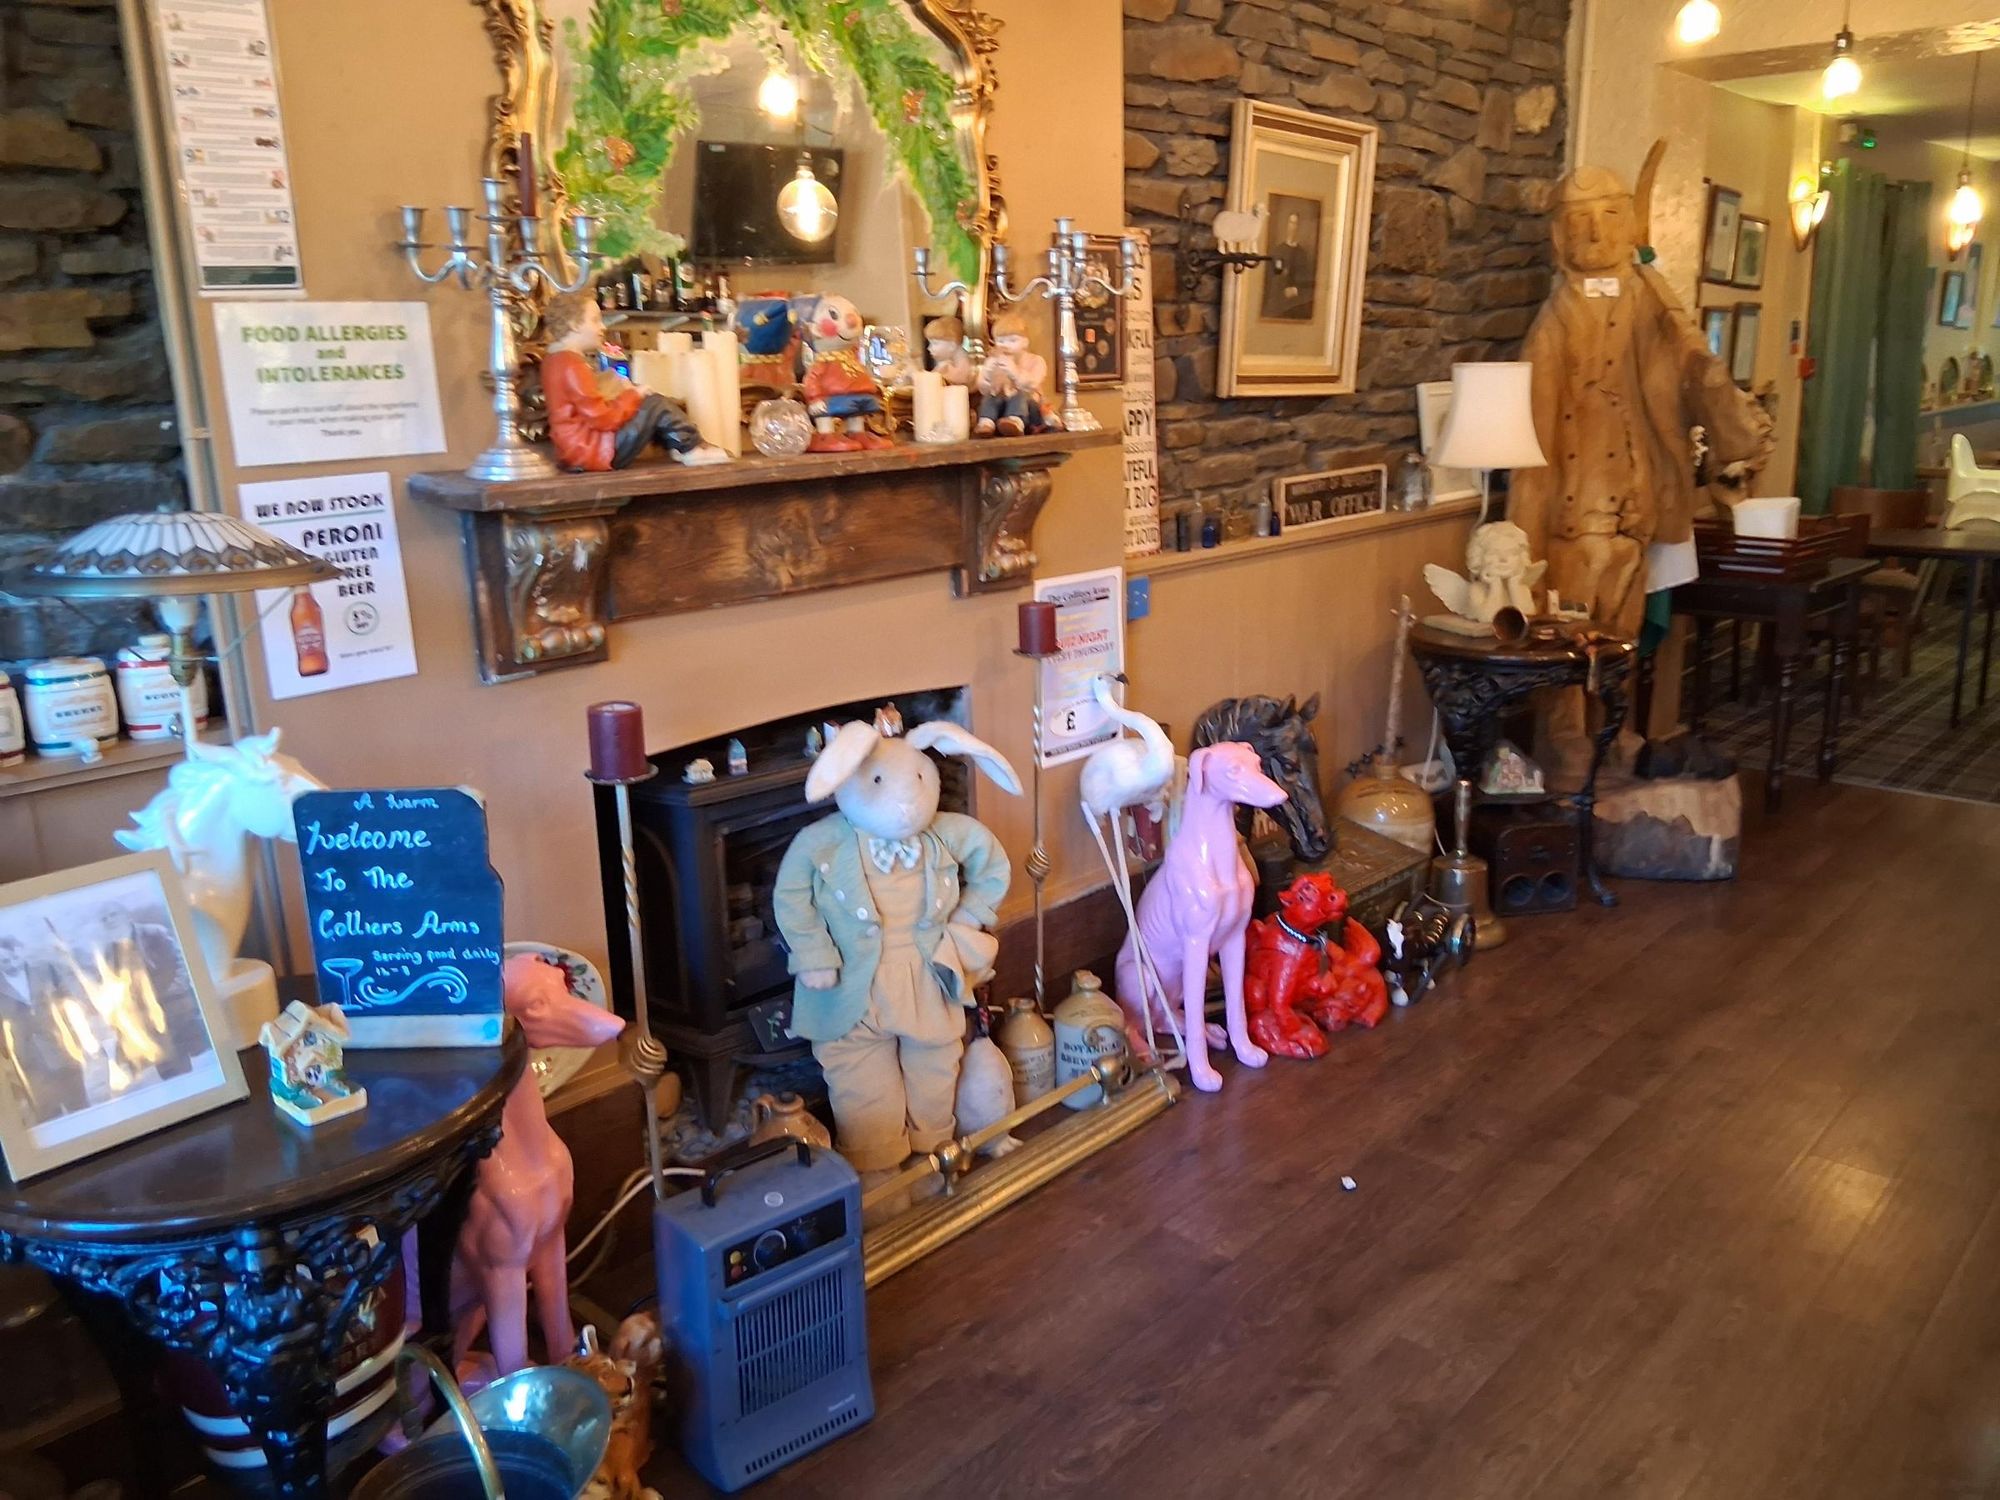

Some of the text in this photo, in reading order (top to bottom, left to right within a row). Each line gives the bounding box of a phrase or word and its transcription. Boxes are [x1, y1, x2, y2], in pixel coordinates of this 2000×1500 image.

[240, 325, 408, 343] FOOD ALLERGIES
[316, 346, 346, 359] and
[256, 364, 405, 383] INTOLERANCES
[256, 493, 384, 518] WE NOW STOCK
[1287, 492, 1376, 523] WAR OFFICE
[303, 523, 383, 548] PERONI
[322, 547, 379, 564] GLUTEN
[337, 564, 372, 580] REE
[338, 581, 376, 597] BEER
[1066, 710, 1076, 731] £
[315, 865, 414, 892] To The
[318, 909, 480, 940] Colliers Arms
[462, 947, 500, 966] daily
